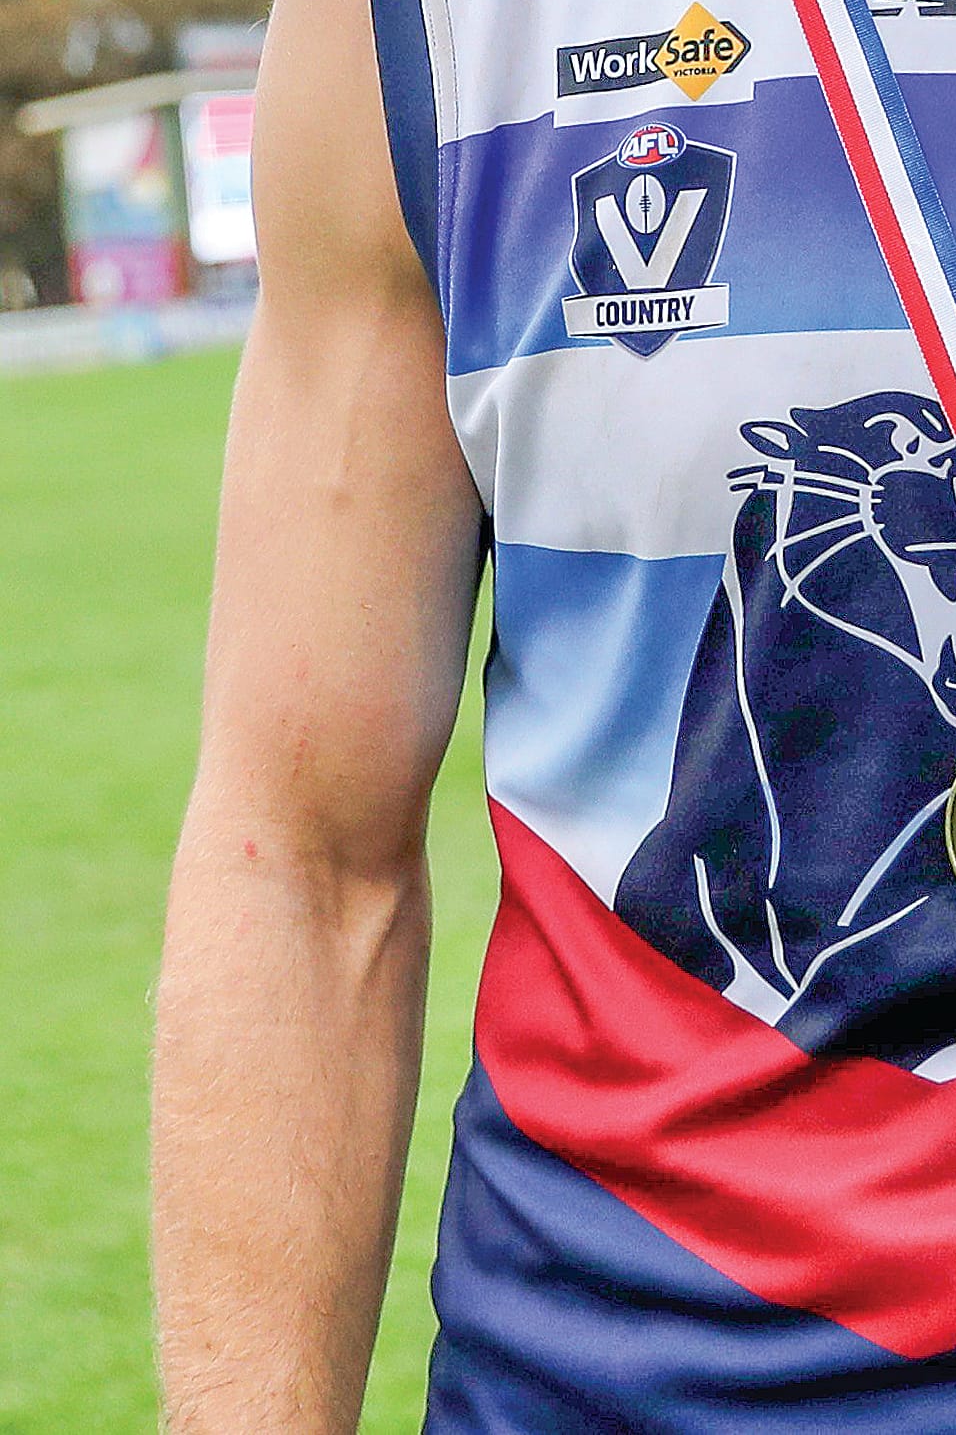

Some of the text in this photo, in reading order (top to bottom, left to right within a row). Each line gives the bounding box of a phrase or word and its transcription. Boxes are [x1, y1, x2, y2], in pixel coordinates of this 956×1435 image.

[673, 68, 717, 77] VICTORIA
[621, 132, 678, 161] AFL
[596, 296, 696, 327] COUNTRY
